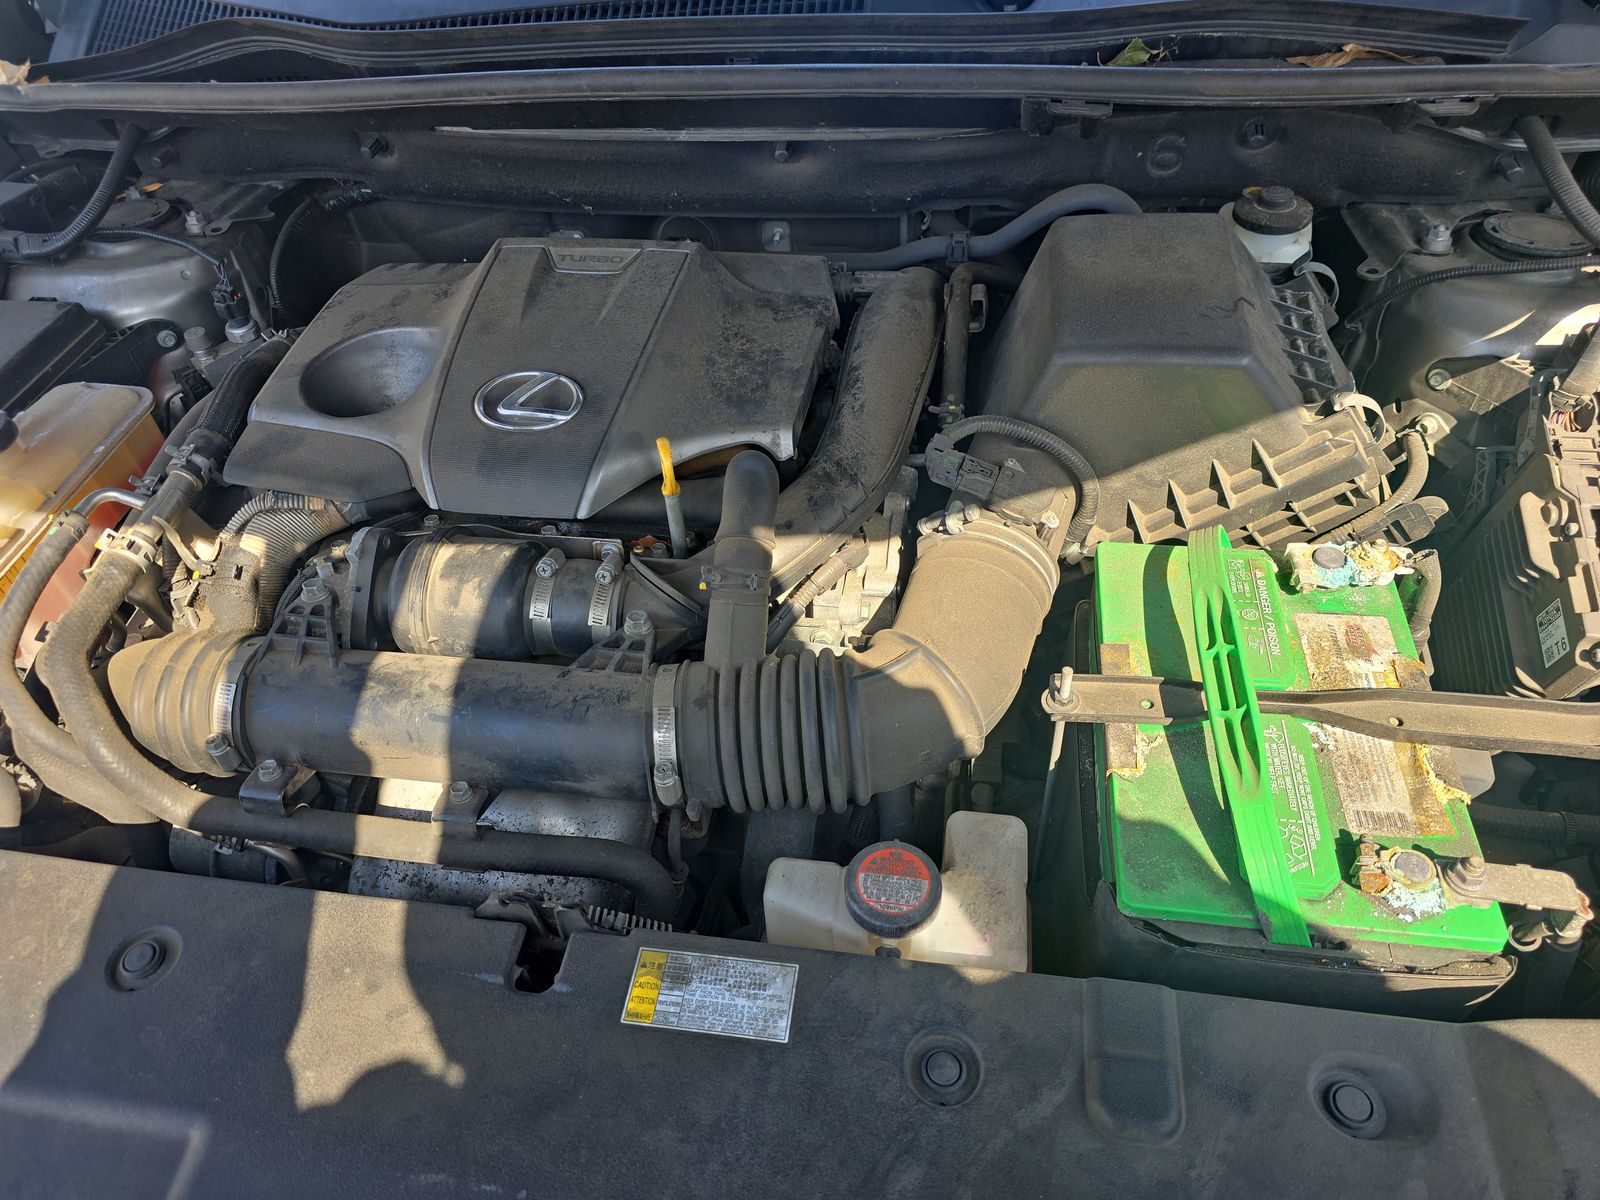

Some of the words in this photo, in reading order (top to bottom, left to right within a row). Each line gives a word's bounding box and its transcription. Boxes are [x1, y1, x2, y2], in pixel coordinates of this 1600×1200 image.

[557, 254, 624, 264] TURBO
[1257, 579, 1272, 614] DANGER
[1266, 622, 1281, 656] POISON
[1554, 637, 1567, 655] T6
[634, 981, 658, 990] CAUTION
[631, 995, 656, 1005] ATTENTION
